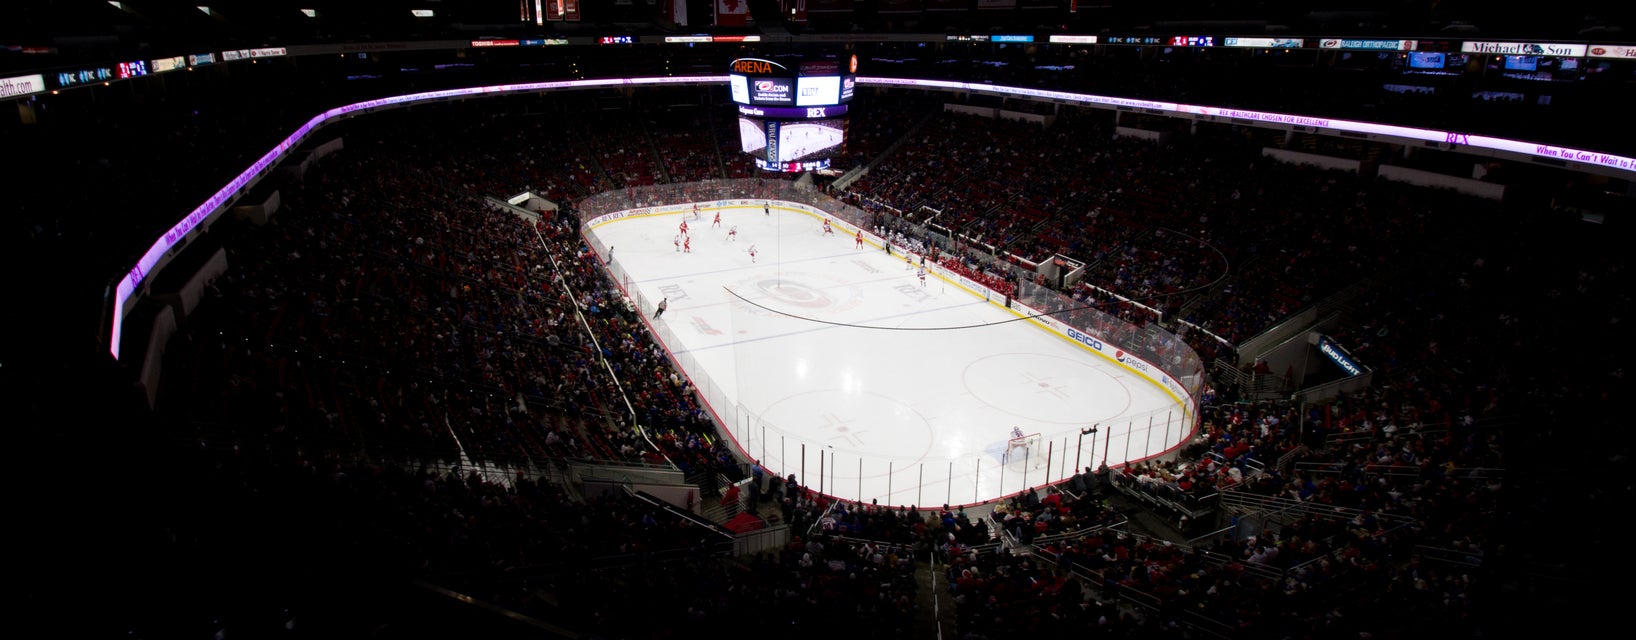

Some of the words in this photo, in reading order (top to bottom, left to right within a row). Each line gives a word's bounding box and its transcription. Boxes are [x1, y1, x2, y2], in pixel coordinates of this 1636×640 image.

[1472, 42, 1520, 53] Michael
[1548, 45, 1572, 55] Son
[734, 61, 772, 73] ARENA
[807, 108, 826, 118] REX
[1230, 110, 1260, 120] HEALTHCARE
[1262, 113, 1282, 122] CHOSEN
[1283, 115, 1294, 123] FOR
[1296, 116, 1329, 127] EXCELLENCE
[1446, 132, 1470, 145] REX
[1536, 145, 1557, 156] When
[1560, 149, 1573, 159] You
[1576, 152, 1597, 162] Can't
[1600, 155, 1617, 166] Wait
[1619, 158, 1627, 168] to
[1067, 328, 1102, 351] GEICO
[1126, 357, 1148, 373] pepsi
[1322, 344, 1339, 360] BUD
[1338, 356, 1360, 376] LIGHT
